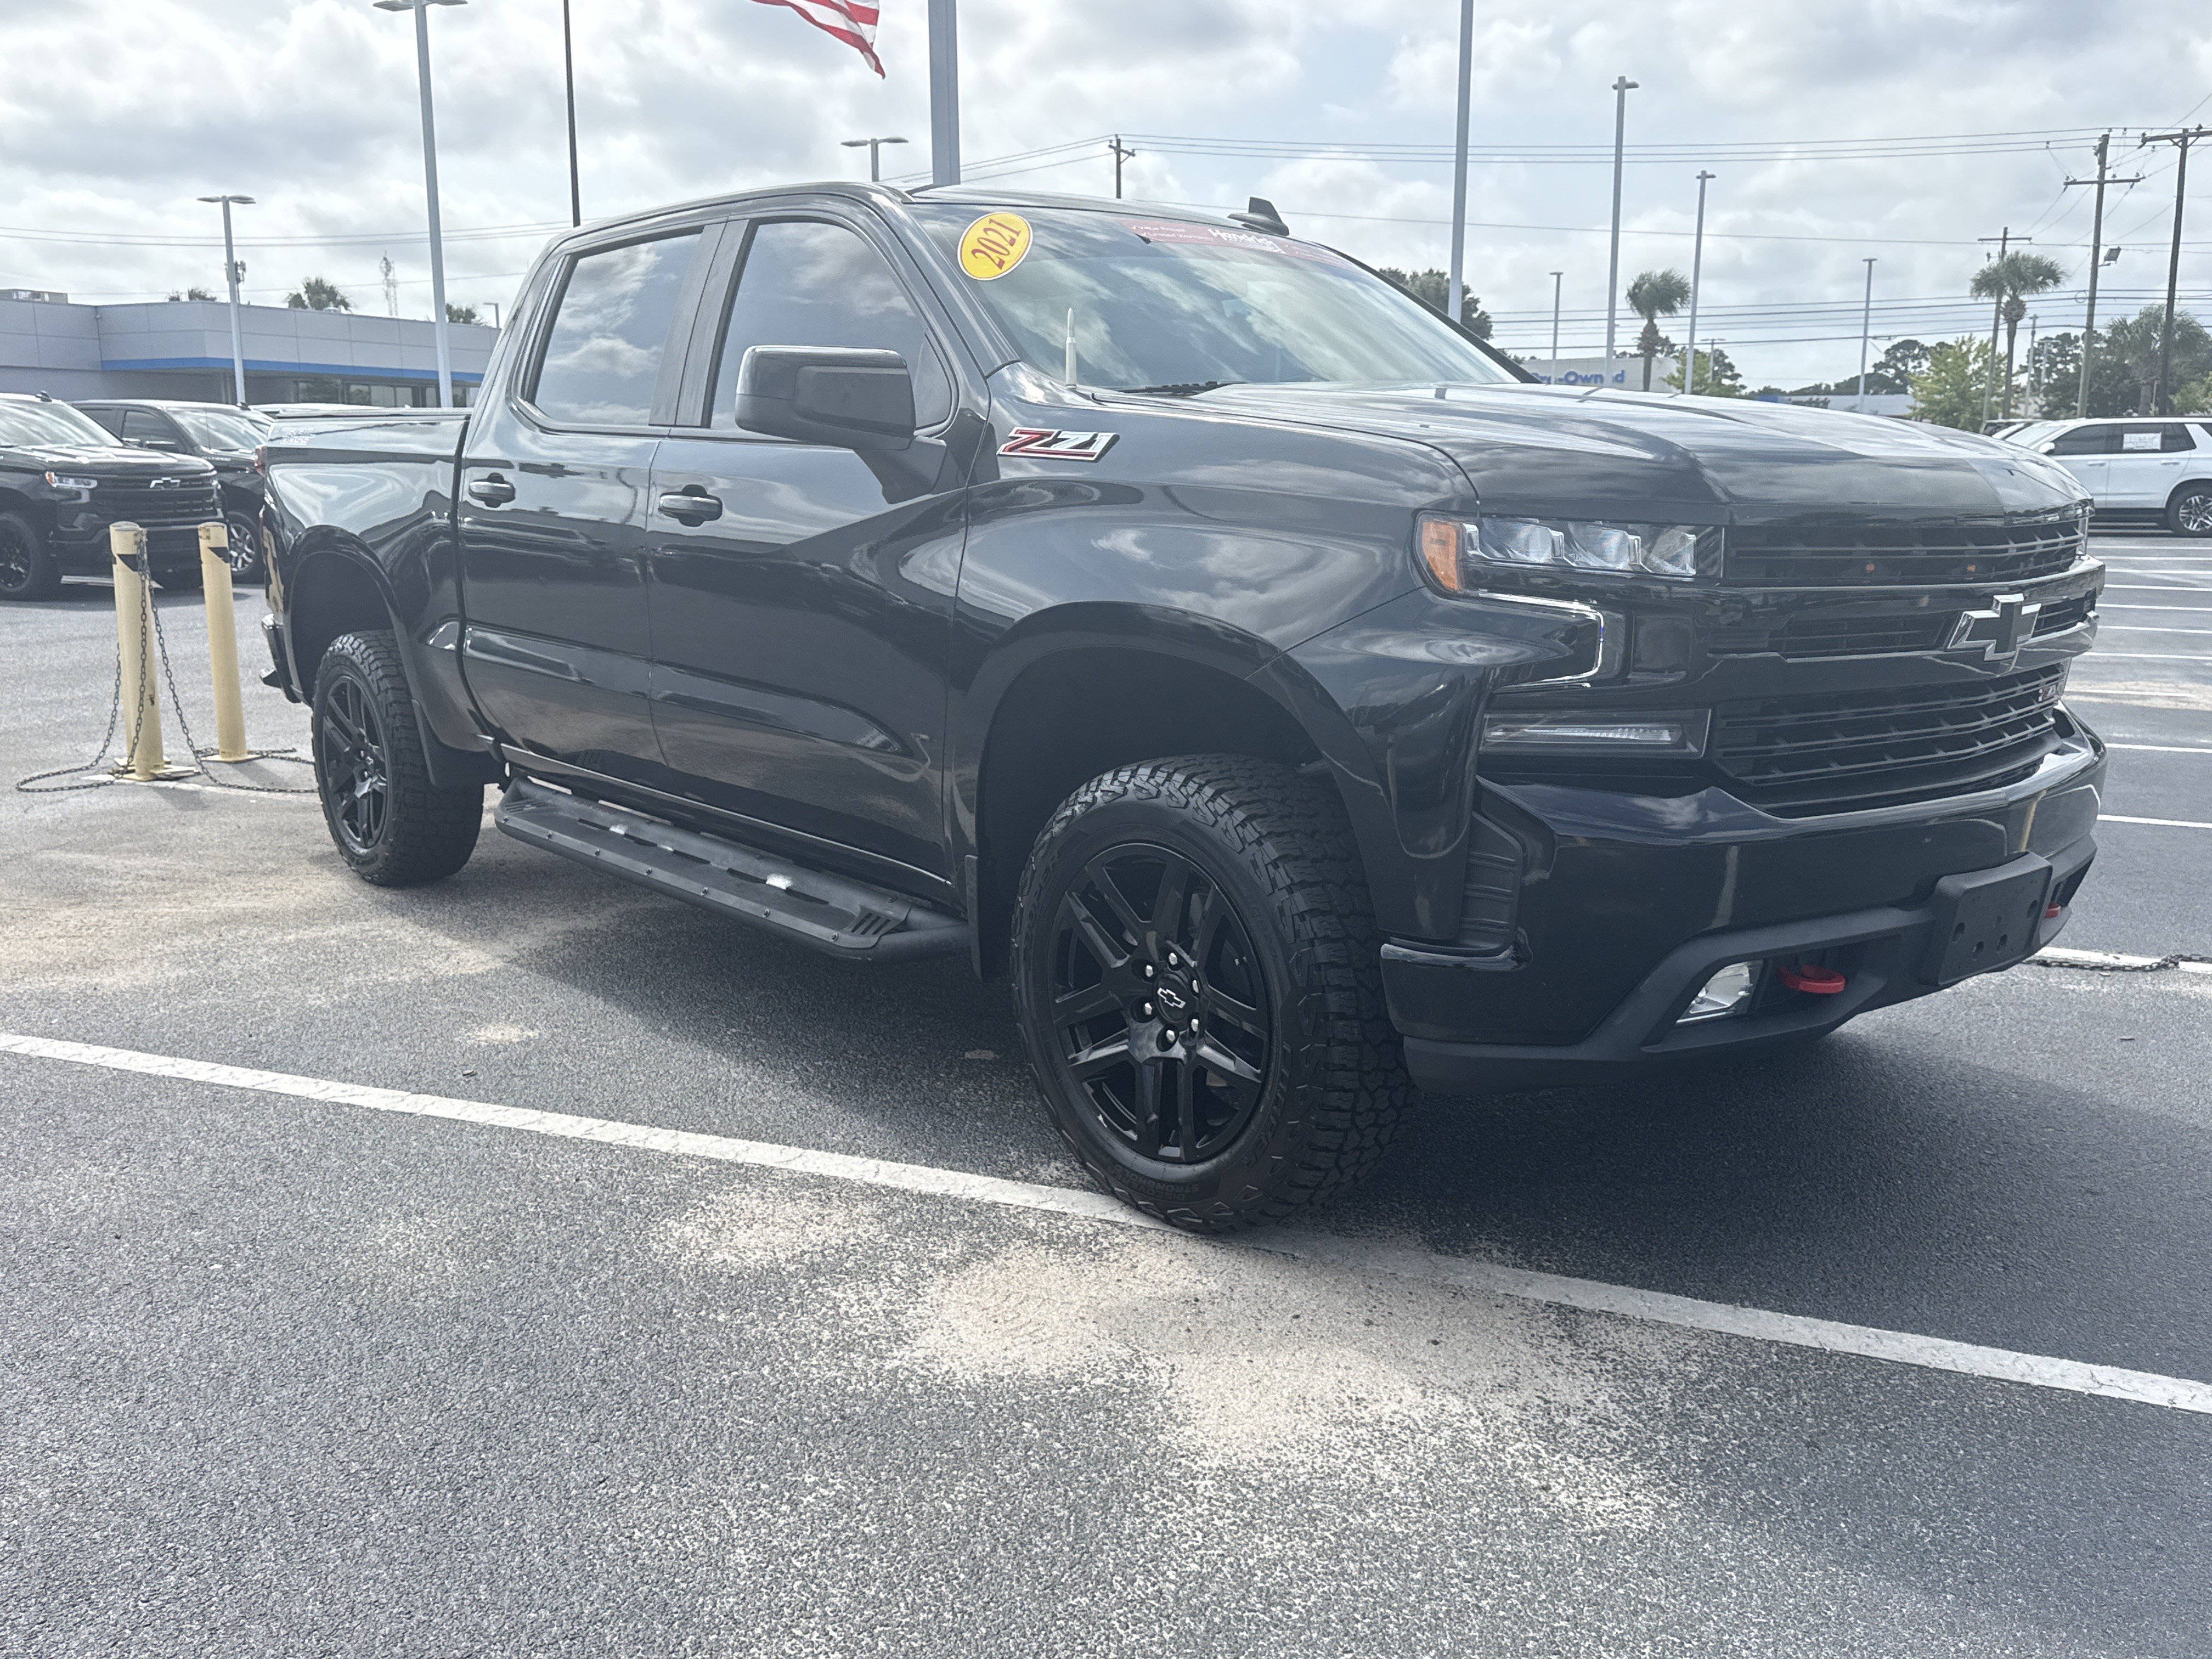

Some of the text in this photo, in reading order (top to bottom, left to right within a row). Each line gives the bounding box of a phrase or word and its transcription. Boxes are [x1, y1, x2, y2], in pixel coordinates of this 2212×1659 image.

[970, 218, 1022, 270] 2021
[1531, 369, 1625, 383] r-Ownd
[281, 427, 317, 439] TRAIL
[996, 426, 1120, 462] Z71
